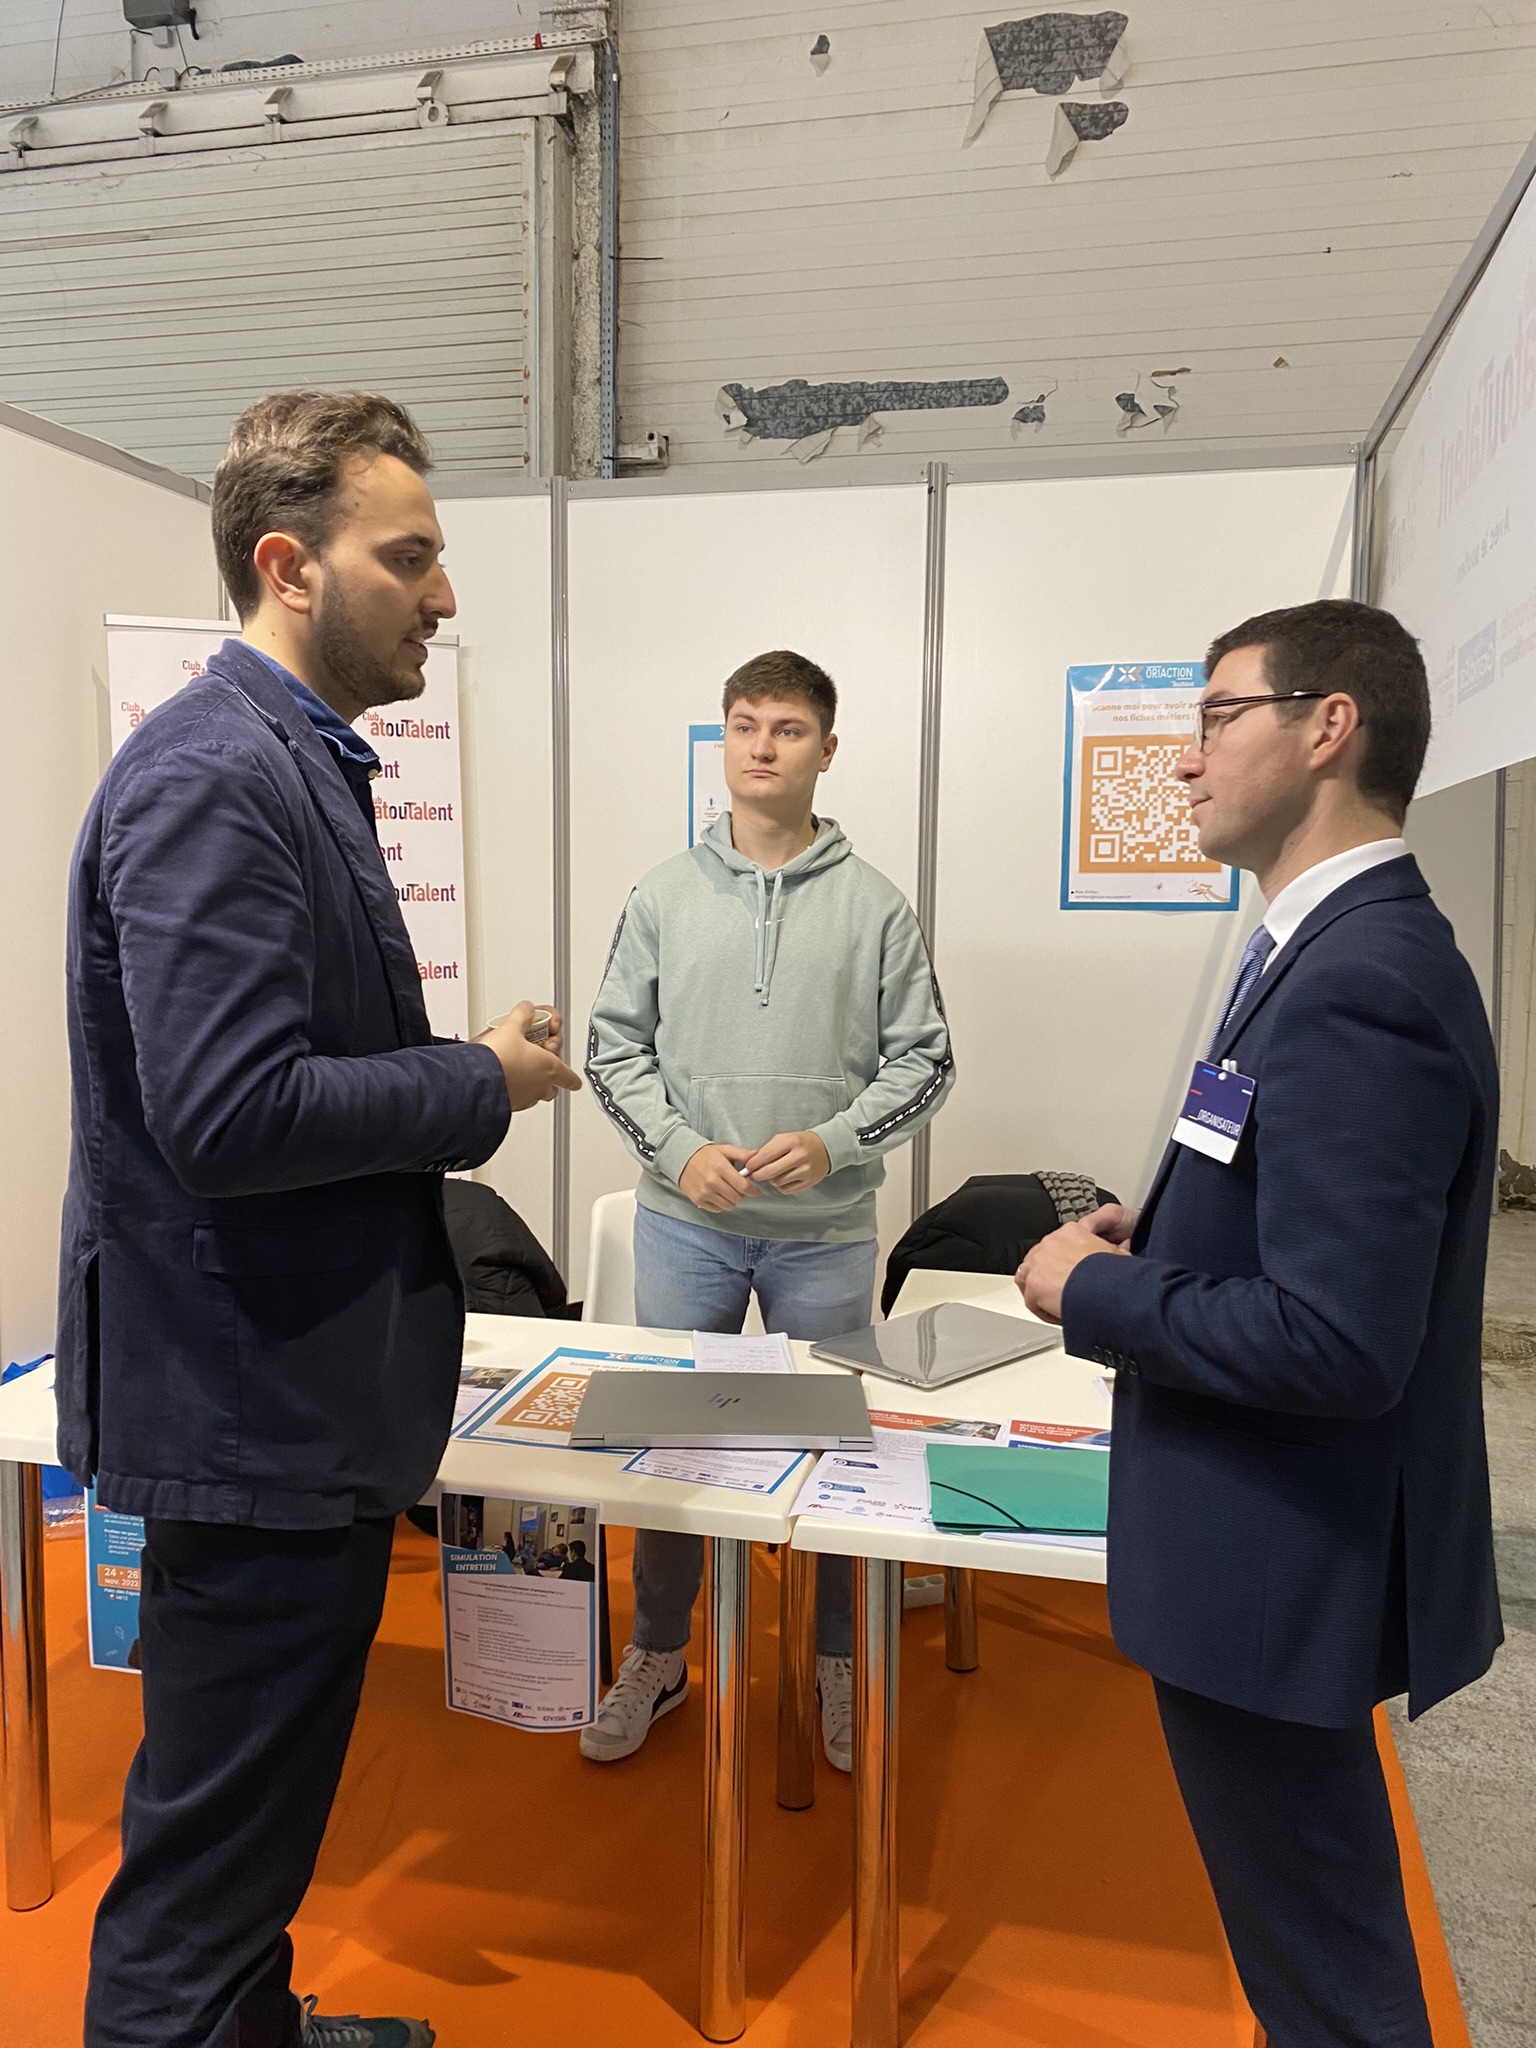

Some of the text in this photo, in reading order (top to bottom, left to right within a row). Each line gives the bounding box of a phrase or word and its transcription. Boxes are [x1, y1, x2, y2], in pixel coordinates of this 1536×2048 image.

[182, 660, 201, 670] Club
[1145, 667, 1193, 680] ORIACTION
[121, 702, 140, 711] Club
[1124, 702, 1140, 710] moi
[1142, 702, 1161, 713] pour
[1164, 701, 1186, 710] avoir
[1113, 714, 1128, 722] nos
[1130, 713, 1155, 721] fiches
[370, 719, 450, 739] atouTalent
[375, 801, 453, 821] atouTalent
[1198, 1109, 1241, 1136] ORGANISATEUR
[633, 1355, 680, 1364] ORIACTION
[450, 1553, 498, 1562] SIMULATION
[104, 1567, 117, 1577] 24
[455, 1563, 497, 1571] ENTRETIEN
